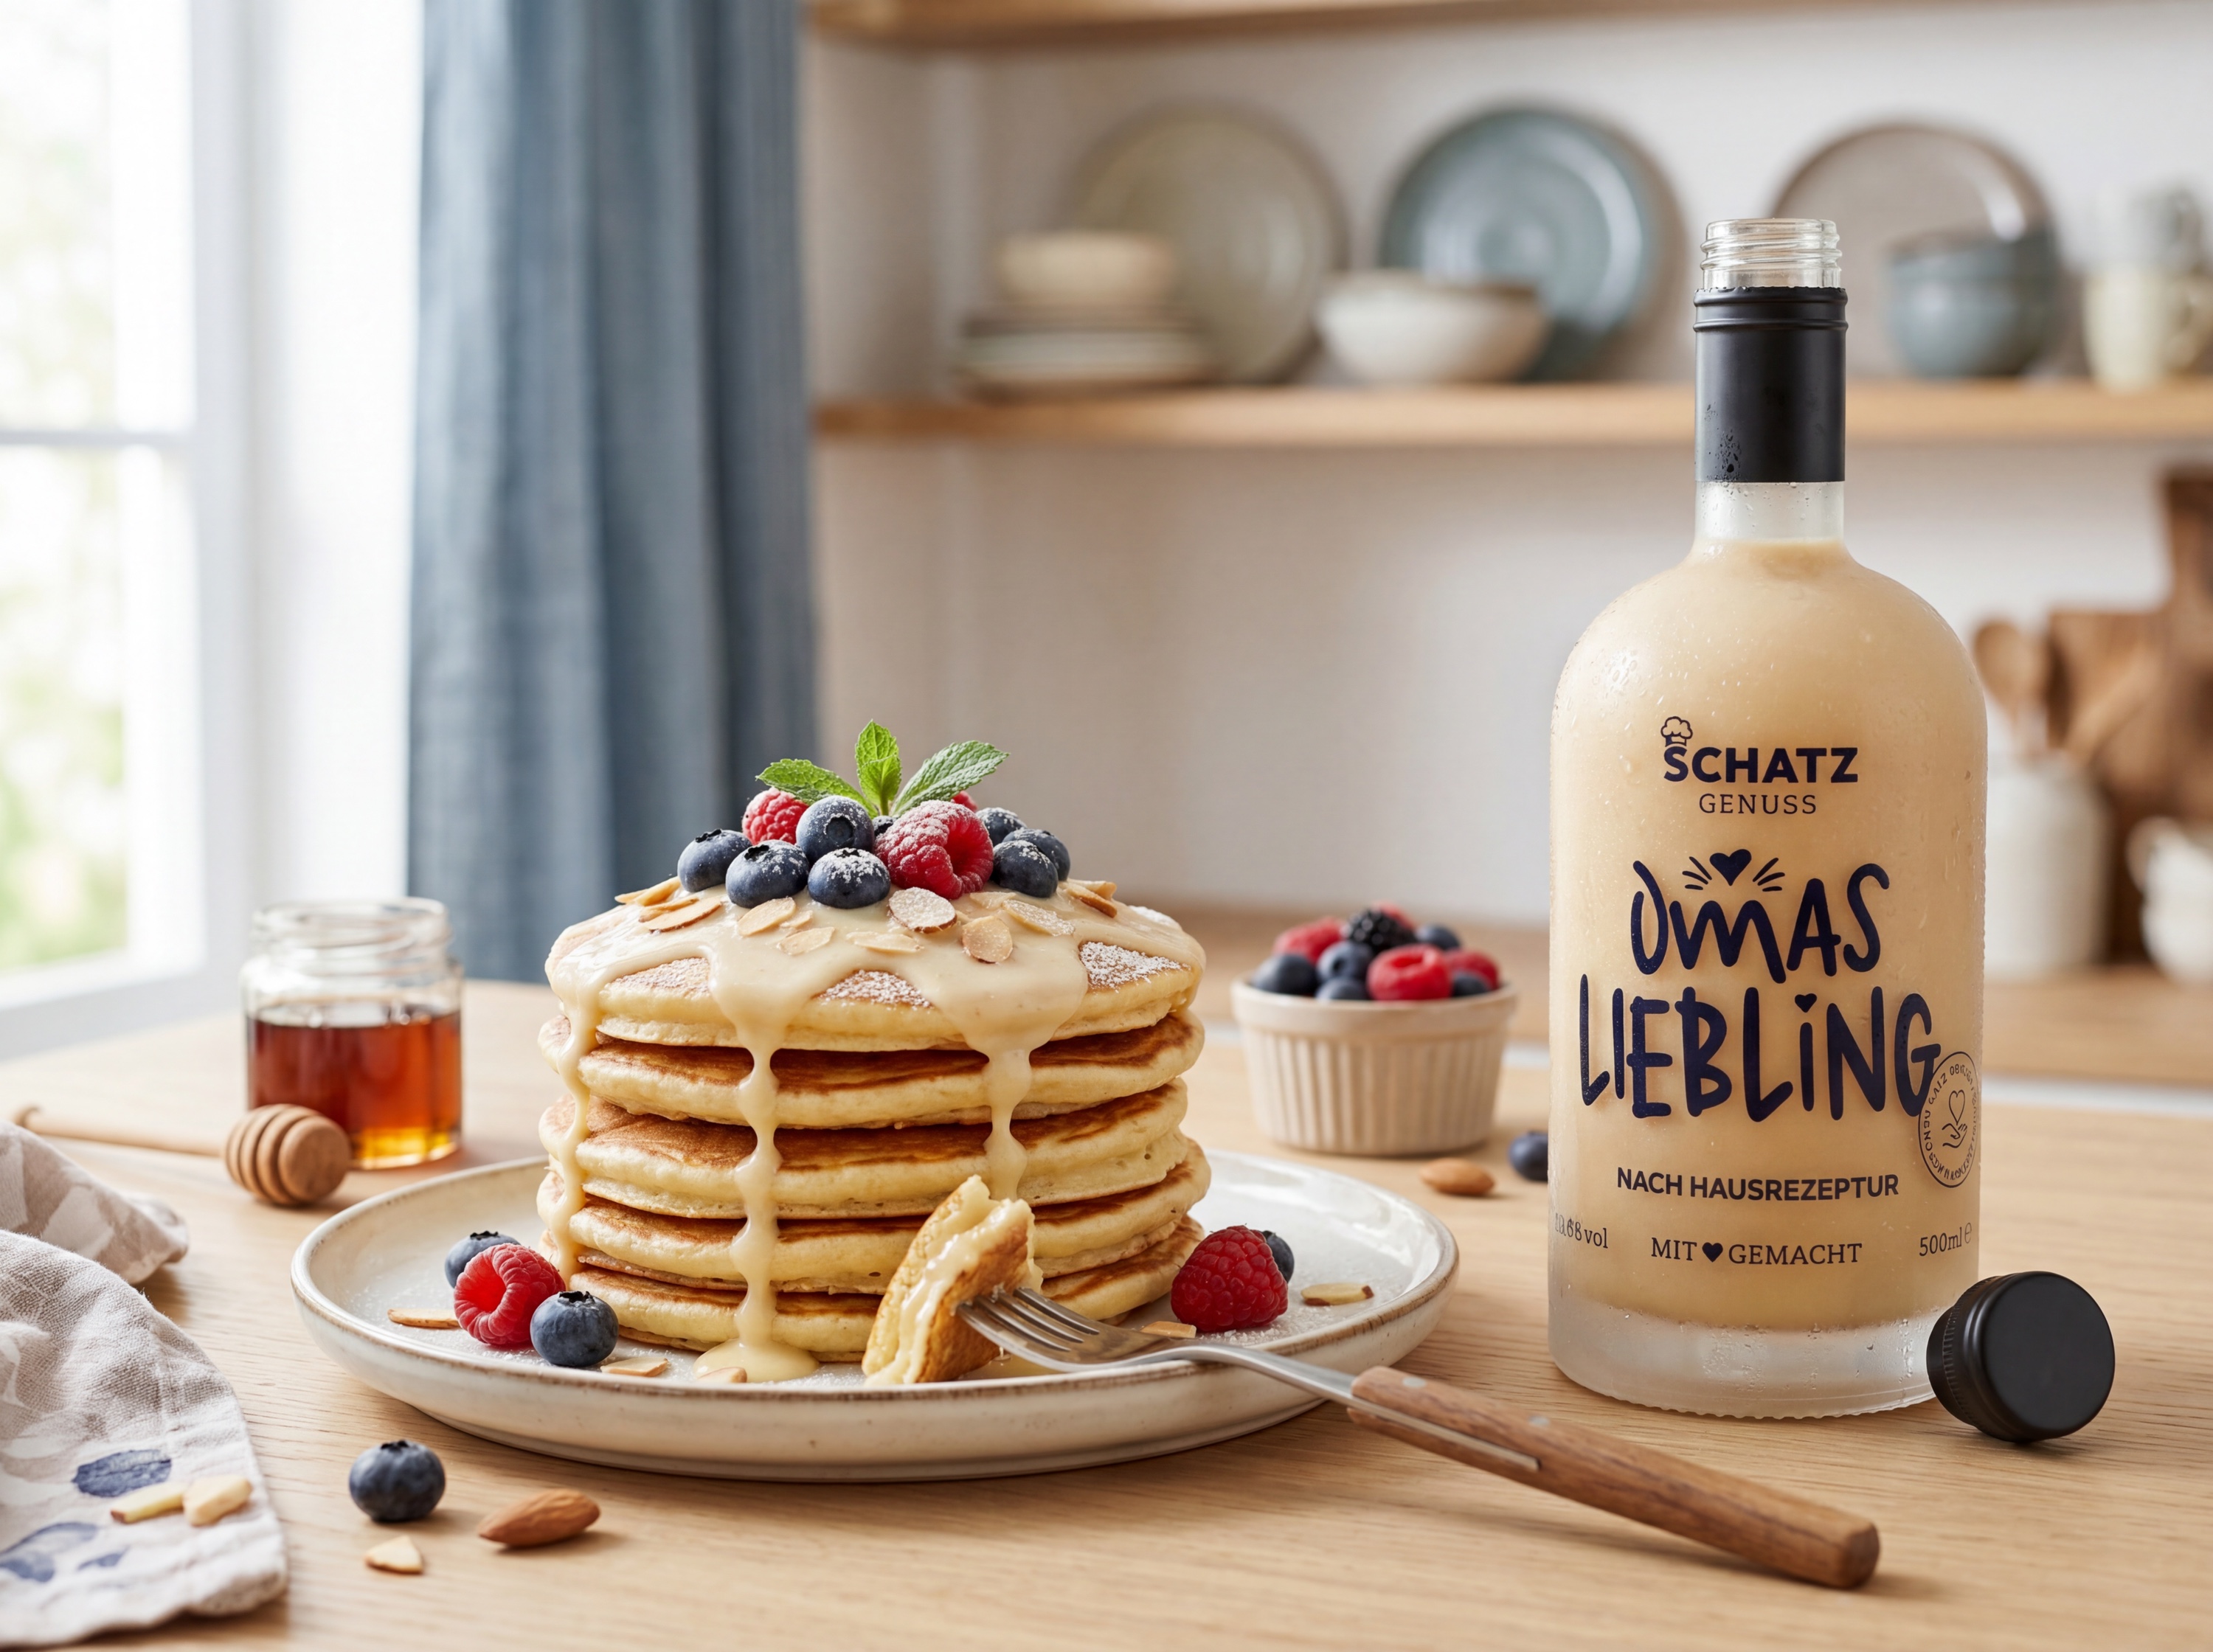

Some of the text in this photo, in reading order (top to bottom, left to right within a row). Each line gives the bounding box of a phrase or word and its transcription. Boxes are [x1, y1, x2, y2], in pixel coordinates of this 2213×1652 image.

[1663, 746, 1858, 784] SCHATZ
[1699, 794, 1816, 815] GENUSS
[1617, 1167, 1899, 1201] NACH HAUSREZEPTUR
[1651, 1237, 1863, 1266] MIT GEMACHT
[1919, 1226, 1962, 1257] 500ml
